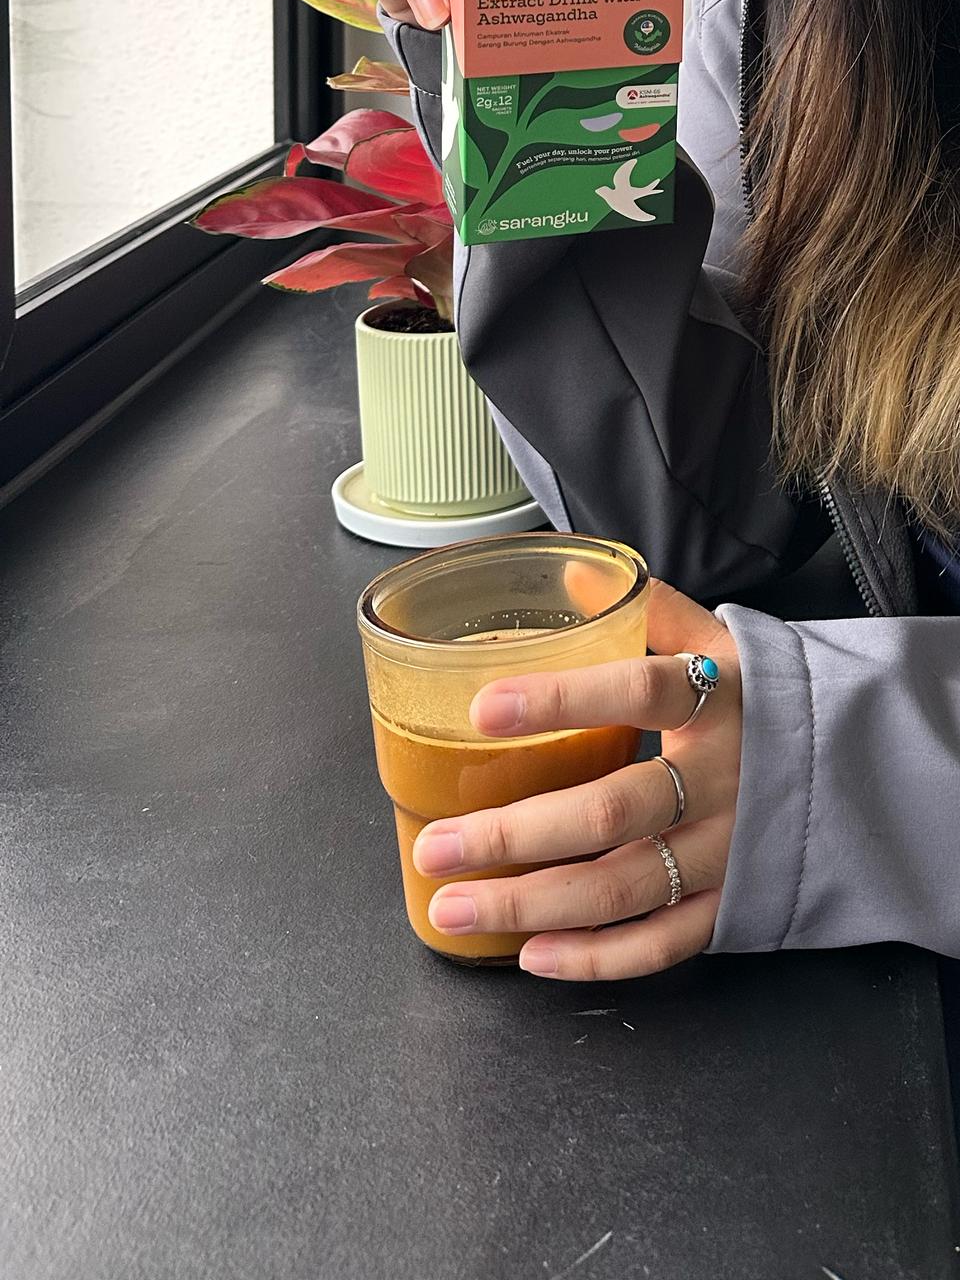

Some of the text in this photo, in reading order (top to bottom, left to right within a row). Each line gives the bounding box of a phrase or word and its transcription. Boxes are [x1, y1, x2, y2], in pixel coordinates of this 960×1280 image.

[477, 9, 598, 26] Ashwagandha
[477, 36, 601, 48] Sarang Burung Dengan Ashwagandha
[516, 156, 534, 169] Fuel
[534, 152, 550, 162] your
[594, 148, 610, 156] your
[611, 145, 633, 154] power
[499, 210, 588, 231] sarangku
